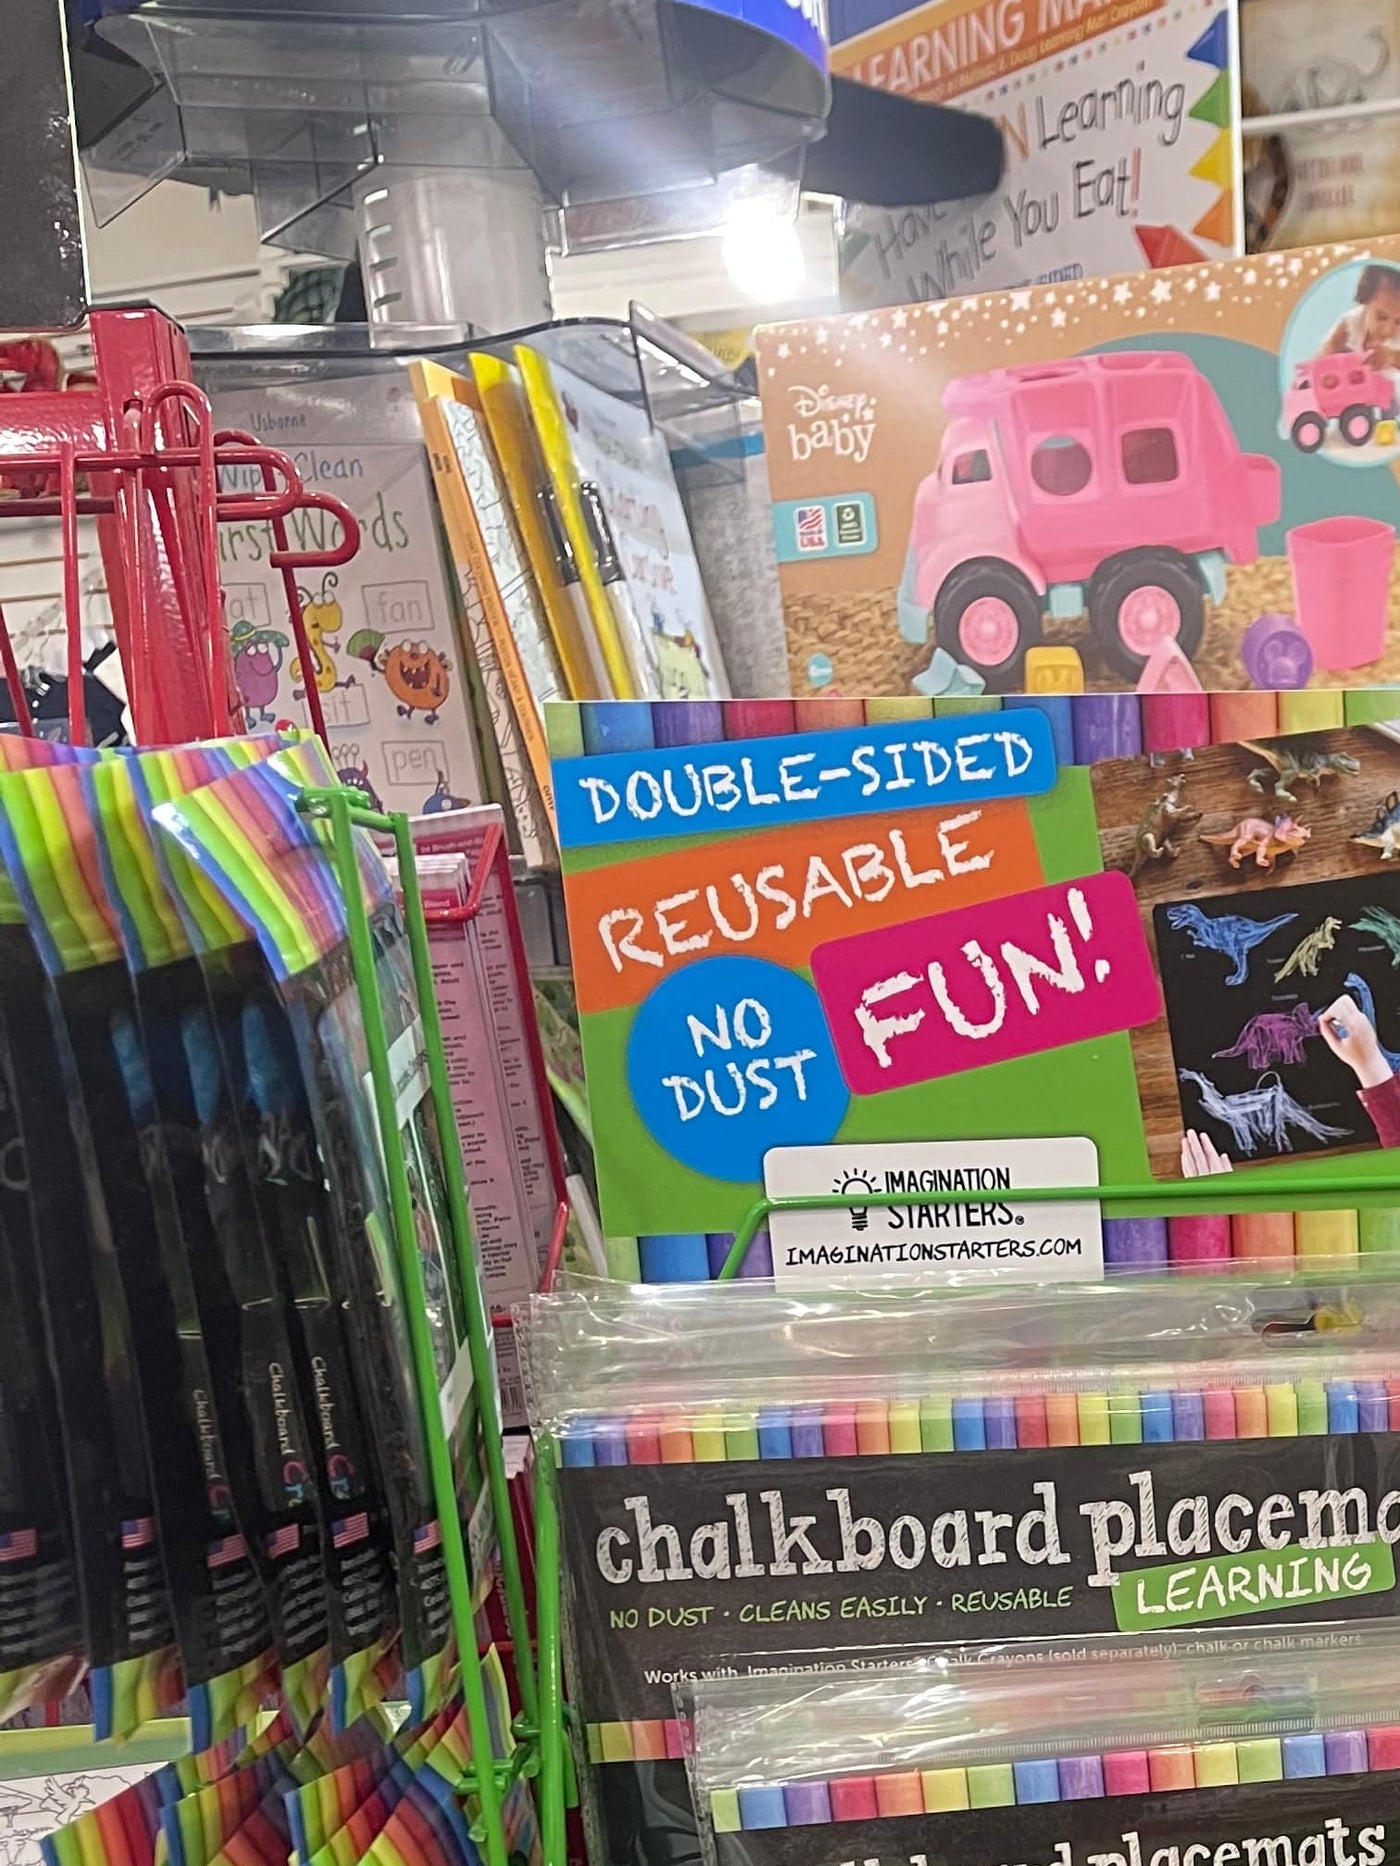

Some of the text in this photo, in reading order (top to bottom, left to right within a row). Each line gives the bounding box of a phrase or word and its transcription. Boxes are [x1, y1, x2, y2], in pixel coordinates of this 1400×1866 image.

[1037, 61, 1186, 149] Learning
[1005, 189, 1060, 248] You
[1074, 148, 1142, 219] Eat!
[788, 414, 877, 464] baby
[392, 745, 437, 774] pen
[579, 730, 1034, 825] DOUBLE-SIDED
[599, 809, 995, 974] REUSABLE
[854, 887, 1111, 1068] FUN!
[686, 997, 772, 1057] NO
[662, 1049, 817, 1122] DUST
[884, 1167, 1010, 1192] IMAGINATION
[785, 1237, 1082, 1267] IMAGINATIONSTARTERS.COM
[269, 1362, 296, 1455] Chalkboard
[311, 1356, 341, 1450] Chalkboard
[596, 1481, 1071, 1585] chalkboard
[609, 1585, 1074, 1629] NO DUST CLEANS EASILY REUSABLE
[1137, 1552, 1372, 1615] LEARNING
[645, 1669, 698, 1685] Works
[1048, 1649, 1087, 1665] (sold
[1299, 1632, 1363, 1650] markers
